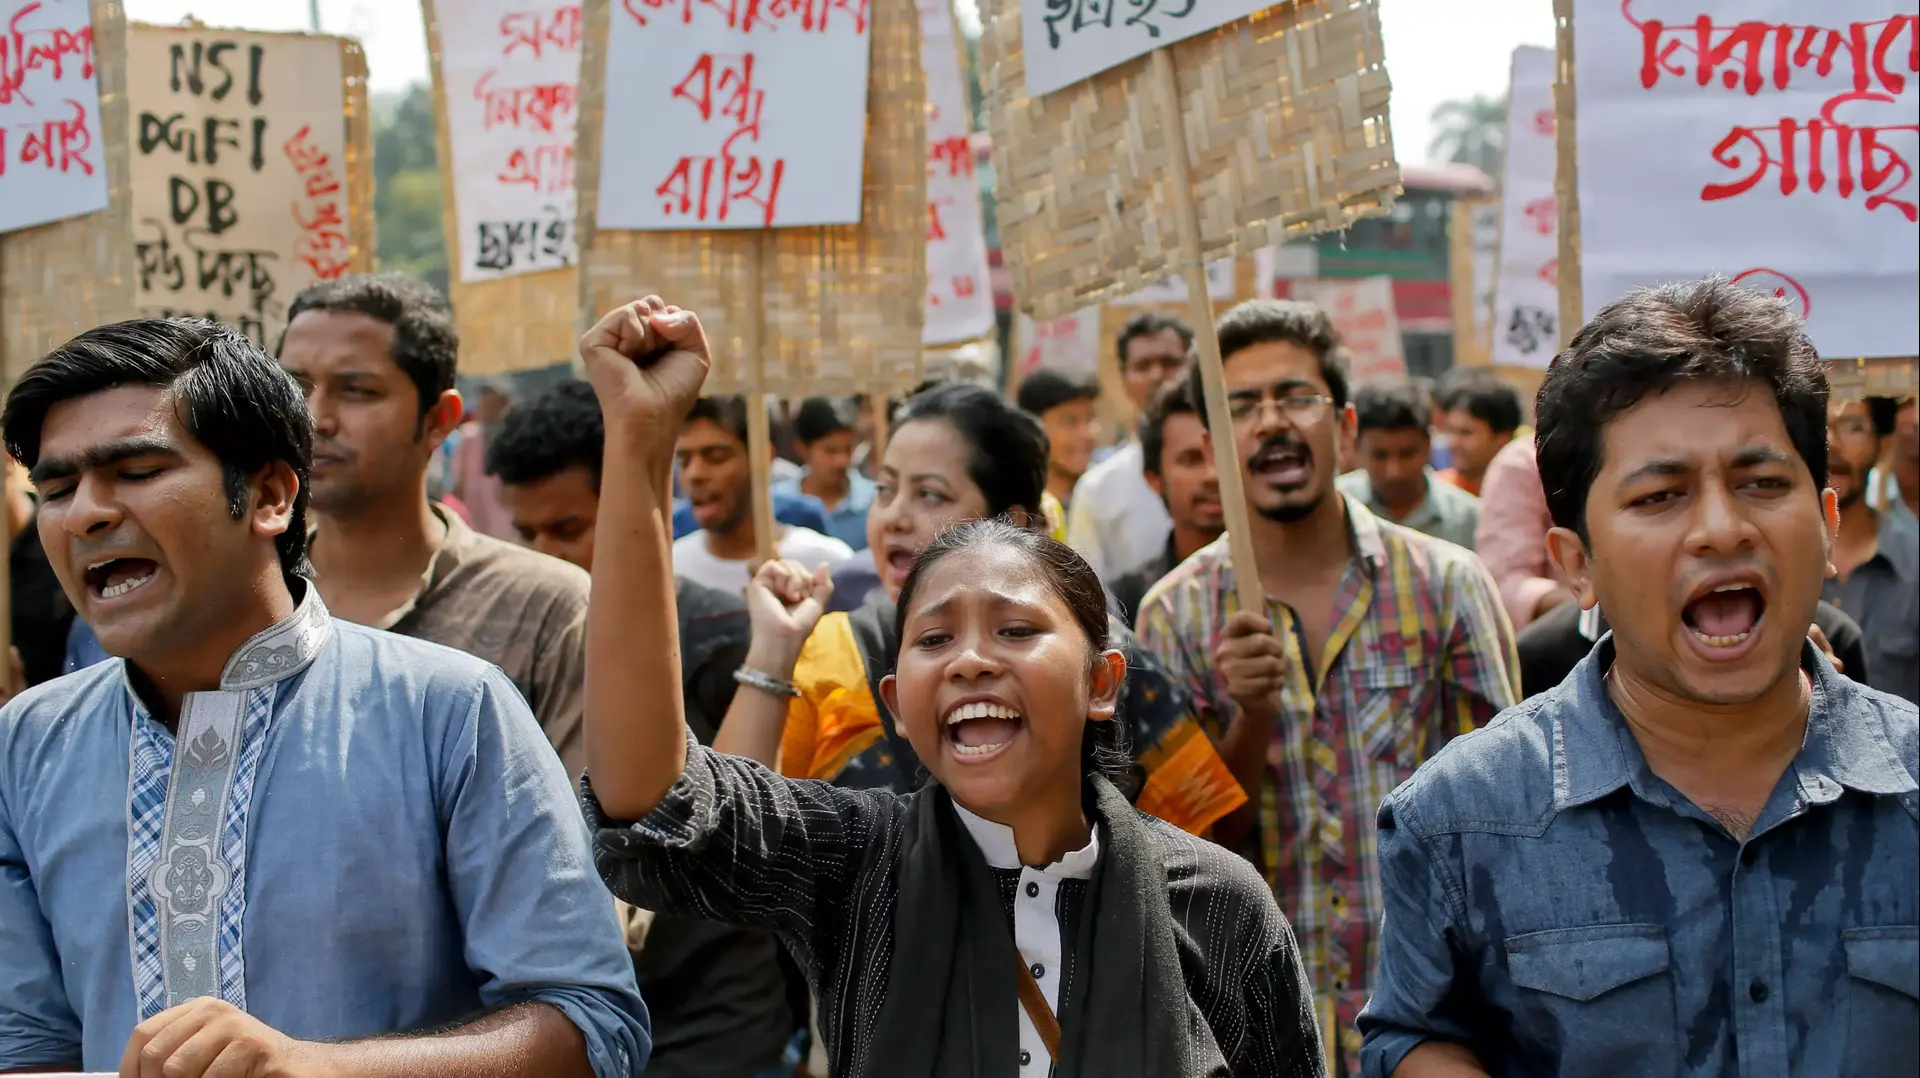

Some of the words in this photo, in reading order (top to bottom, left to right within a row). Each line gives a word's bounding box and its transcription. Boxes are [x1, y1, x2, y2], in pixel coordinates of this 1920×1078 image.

[171, 42, 263, 105] NSI
[139, 113, 266, 171] DGFI
[1701, 91, 1918, 222] আছি
[170, 177, 238, 235] DB
